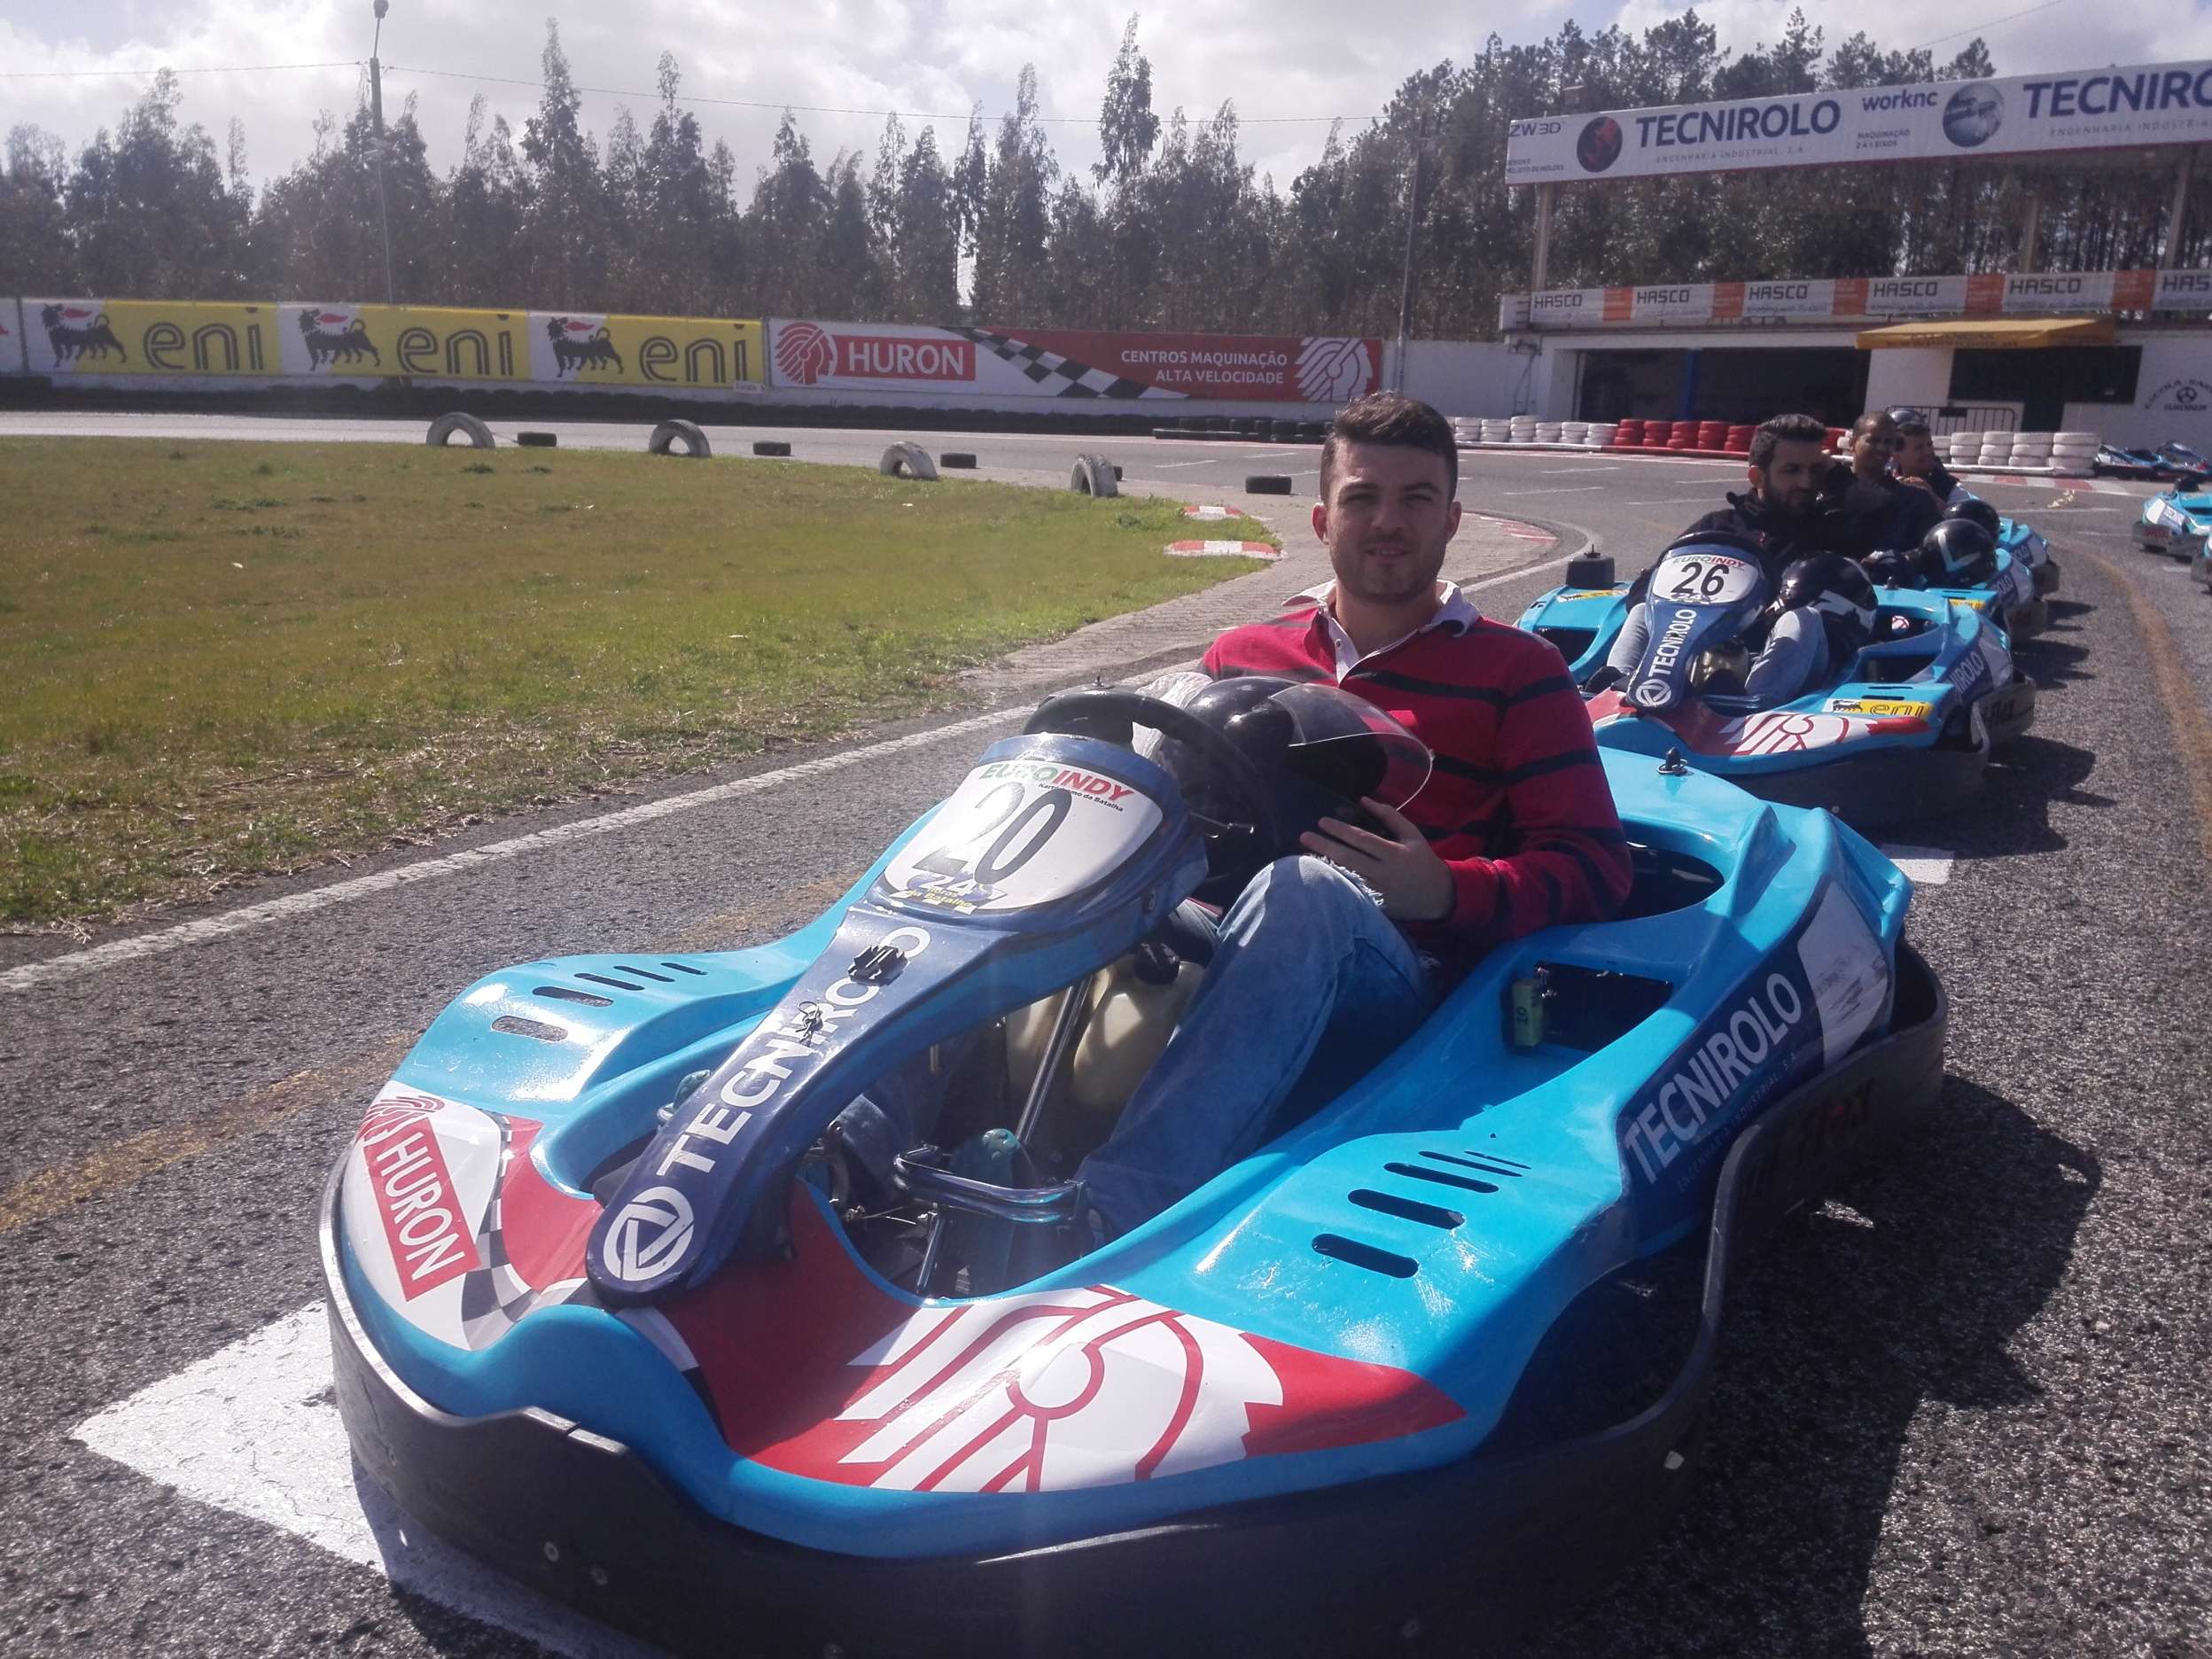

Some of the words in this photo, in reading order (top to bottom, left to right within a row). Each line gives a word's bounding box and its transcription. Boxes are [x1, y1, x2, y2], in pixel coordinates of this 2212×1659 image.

[1862, 90, 1938, 112] worknc
[1635, 99, 1841, 148] TECNIROLO
[1637, 289, 1690, 305] HASCO
[1749, 284, 1808, 300] HASCO
[1873, 281, 1938, 298] HASCO
[2009, 277, 2082, 294] HASCO
[1534, 294, 1583, 309] HASCO
[143, 306, 262, 372] eni
[396, 314, 514, 377] eni
[639, 323, 747, 384] eni
[848, 341, 964, 377] HURON
[1120, 349, 1187, 365] CENTROS
[1190, 348, 1288, 368] MAQUINAÇÃO
[1156, 369, 1191, 383] ALTA
[1195, 370, 1284, 385] VELOCIDADE
[1672, 555, 1745, 567] EUROINDY
[1671, 561, 1730, 596] 26
[1869, 701, 1927, 716] eni
[978, 763, 1135, 802] EUROINDY
[1094, 797, 1124, 812] Batalha
[912, 781, 1072, 885] 20
[656, 926, 931, 1177] TECNIROO
[1624, 973, 1802, 1185] TECNIROLO
[376, 1131, 466, 1281] HURON
